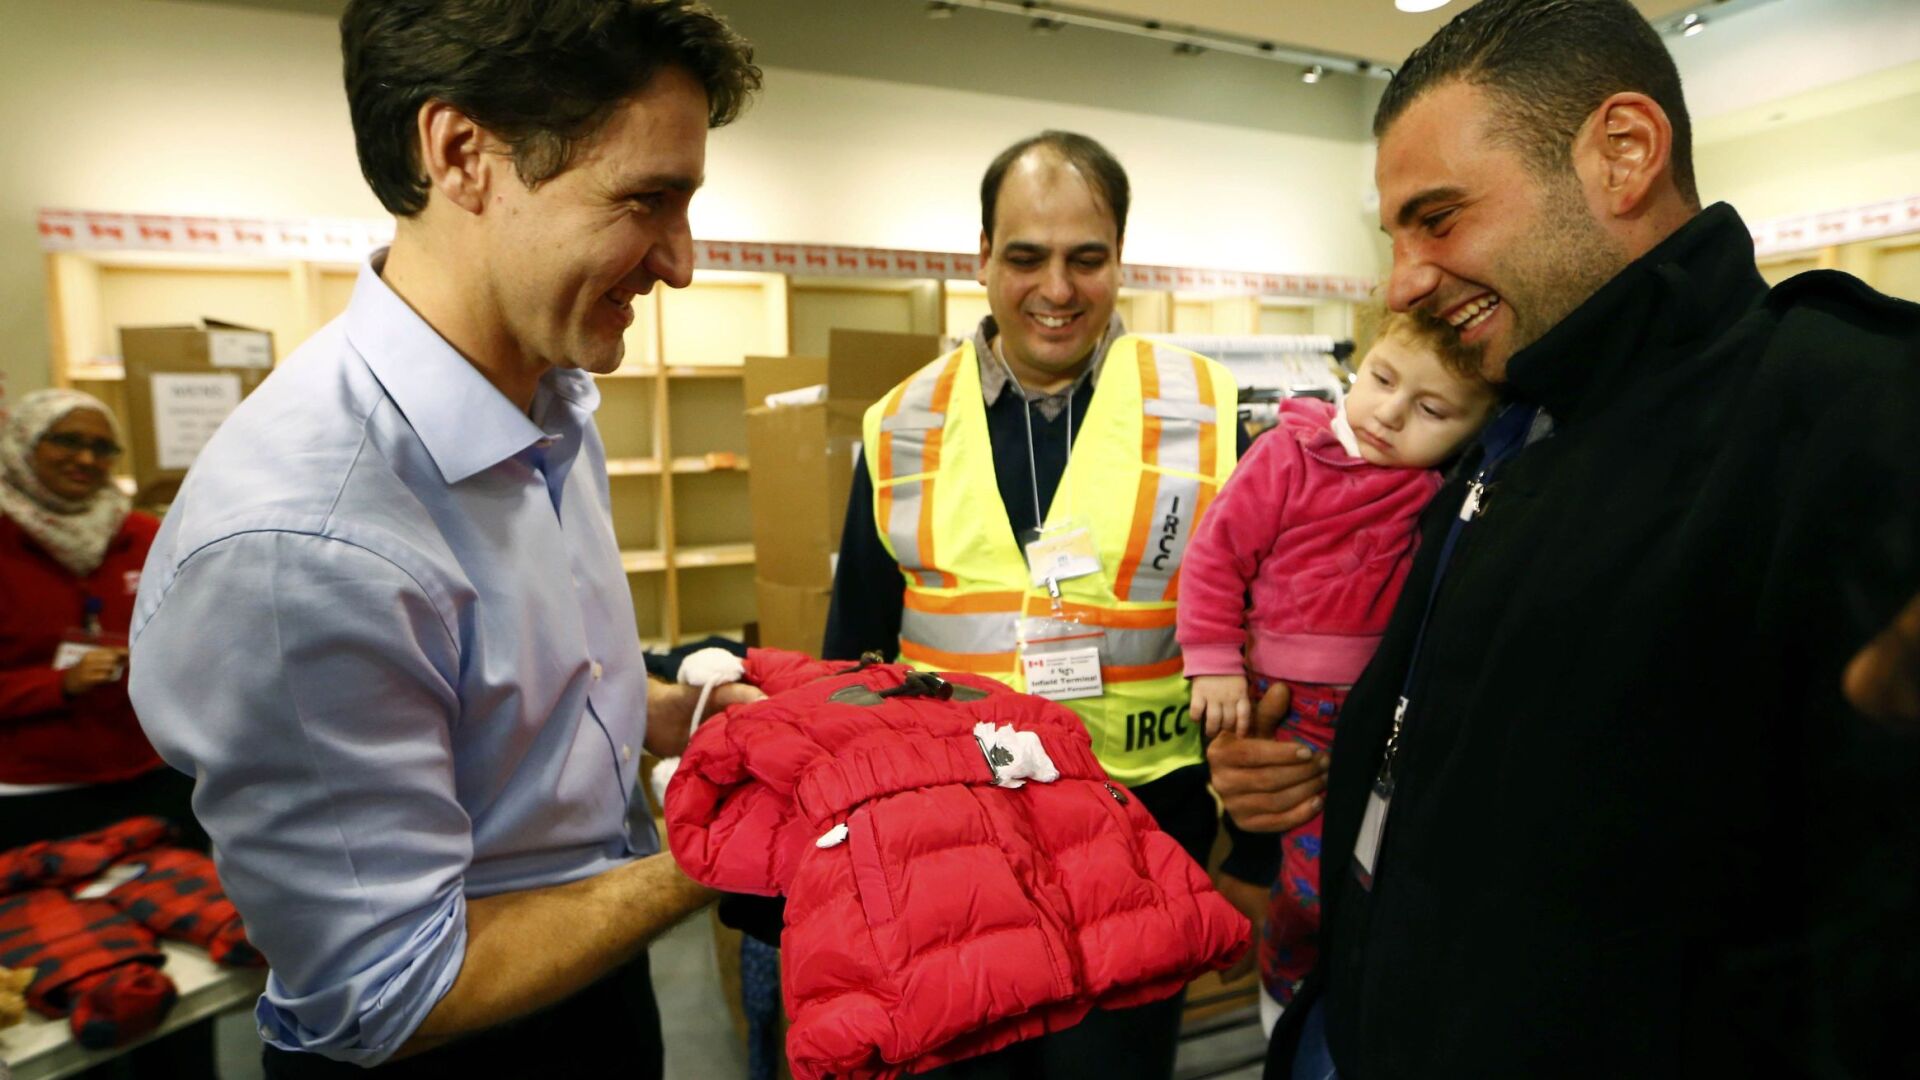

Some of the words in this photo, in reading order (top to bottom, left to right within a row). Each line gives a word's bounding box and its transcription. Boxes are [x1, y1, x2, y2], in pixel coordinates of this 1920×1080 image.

[1152, 496, 1180, 571] IRCC
[1060, 675, 1098, 684] Terminal
[1125, 703, 1191, 752] IRCC
